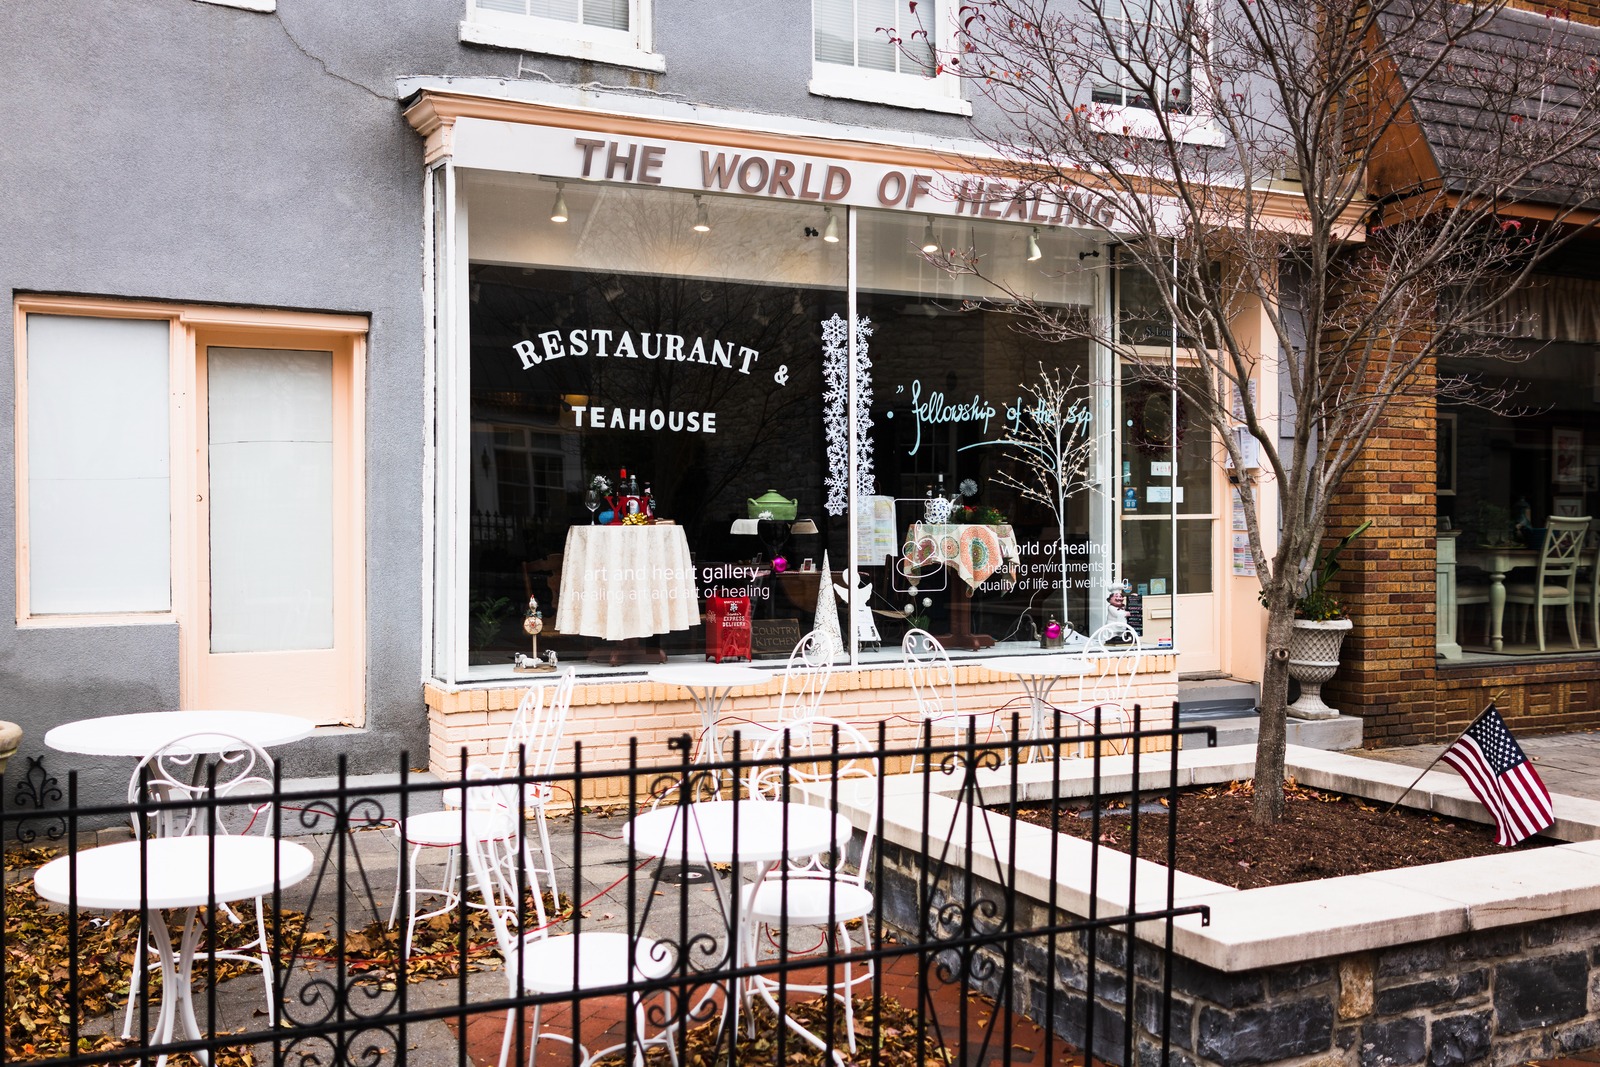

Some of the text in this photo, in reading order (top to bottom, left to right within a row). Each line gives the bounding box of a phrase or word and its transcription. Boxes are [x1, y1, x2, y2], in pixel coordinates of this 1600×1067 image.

[575, 138, 1118, 228] THE WORLD OF HEALING
[512, 329, 789, 387] RESTAURANT &
[571, 405, 717, 434] TEAHOUSE
[1006, 396, 1023, 436] of
[1030, 397, 1056, 424] the
[1001, 541, 1109, 558] world of healing
[583, 564, 760, 583] art and heart gallery
[987, 563, 1028, 577] healing
[1031, 562, 1103, 574] environments
[571, 590, 624, 604] healing
[651, 586, 679, 600] and
[683, 585, 700, 599] art
[703, 585, 718, 599] of
[721, 584, 770, 600] healing
[979, 579, 1016, 594] quality
[1018, 578, 1031, 590] of
[1034, 578, 1049, 590] life
[1051, 577, 1072, 589] and
[751, 626, 797, 637] COUNTRY
[755, 636, 797, 647] KITCHEN
